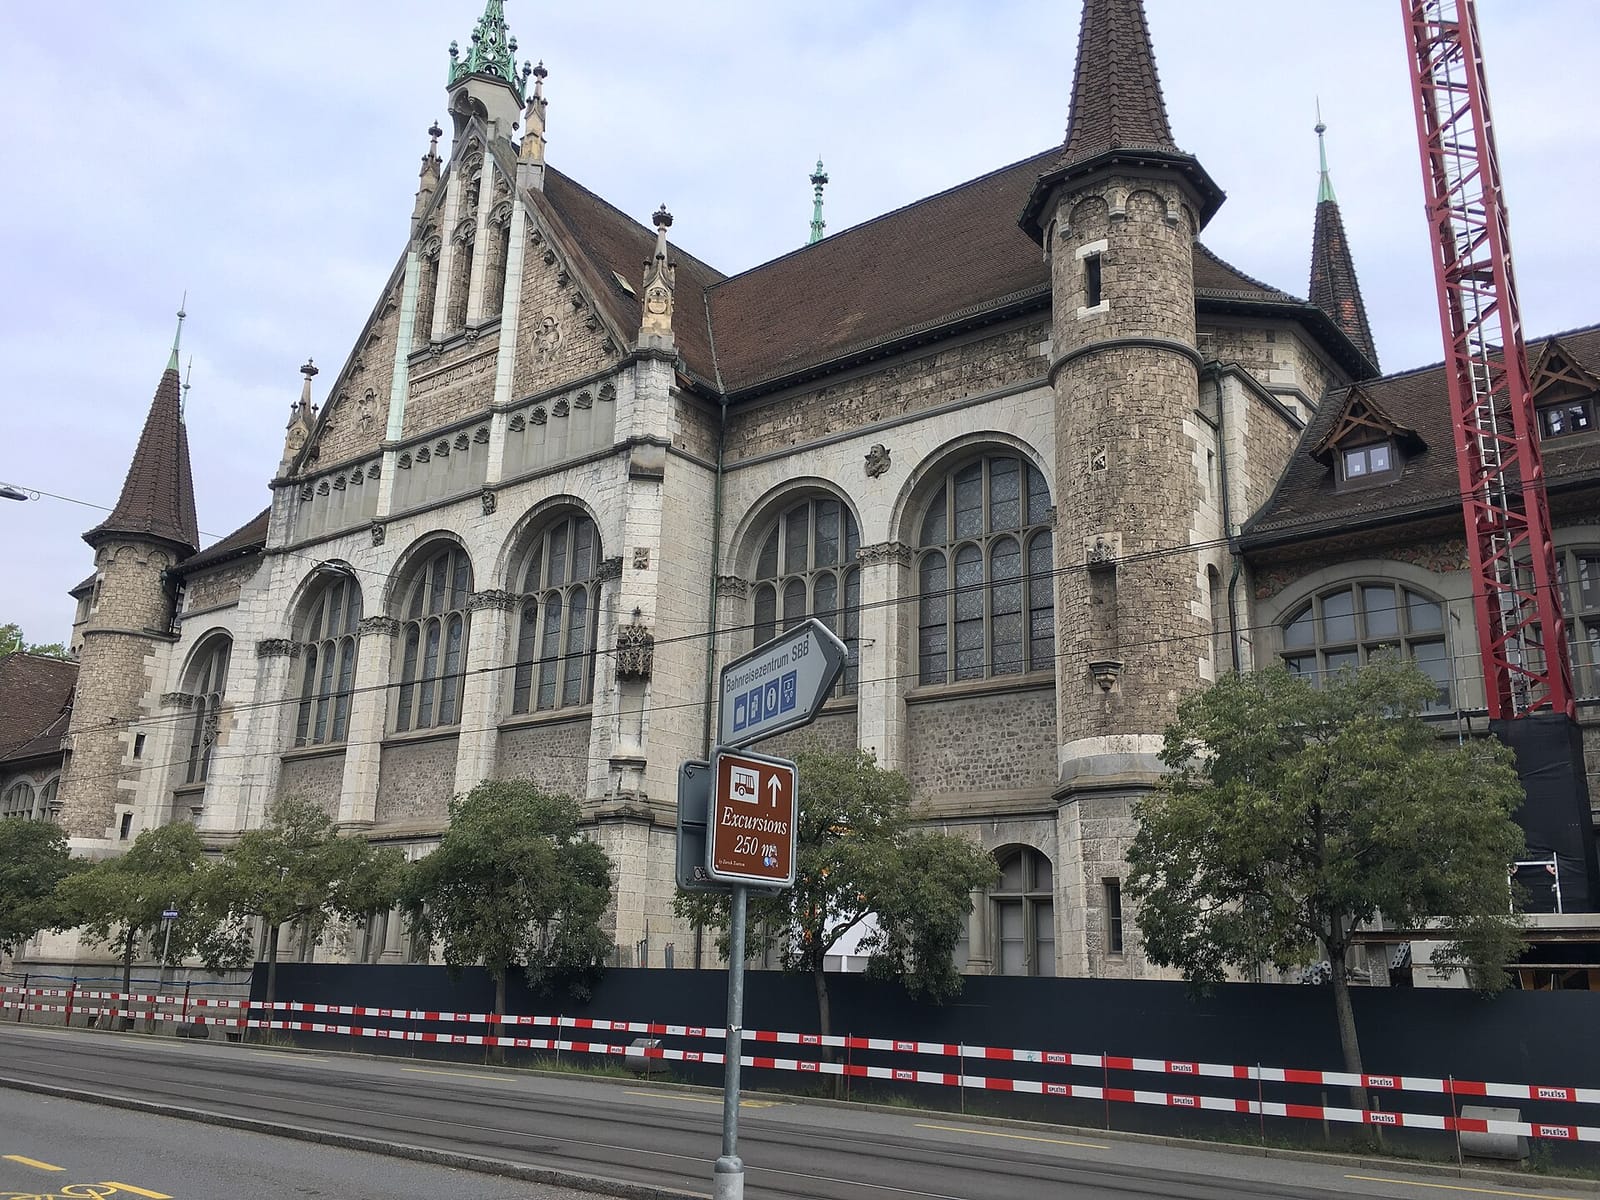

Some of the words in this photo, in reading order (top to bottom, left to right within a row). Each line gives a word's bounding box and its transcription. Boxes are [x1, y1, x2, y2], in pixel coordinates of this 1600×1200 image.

[726, 655, 789, 692] Bahnreisezentrum
[791, 640, 809, 661] SBB
[721, 806, 787, 835] Excursions
[734, 834, 758, 855] 250
